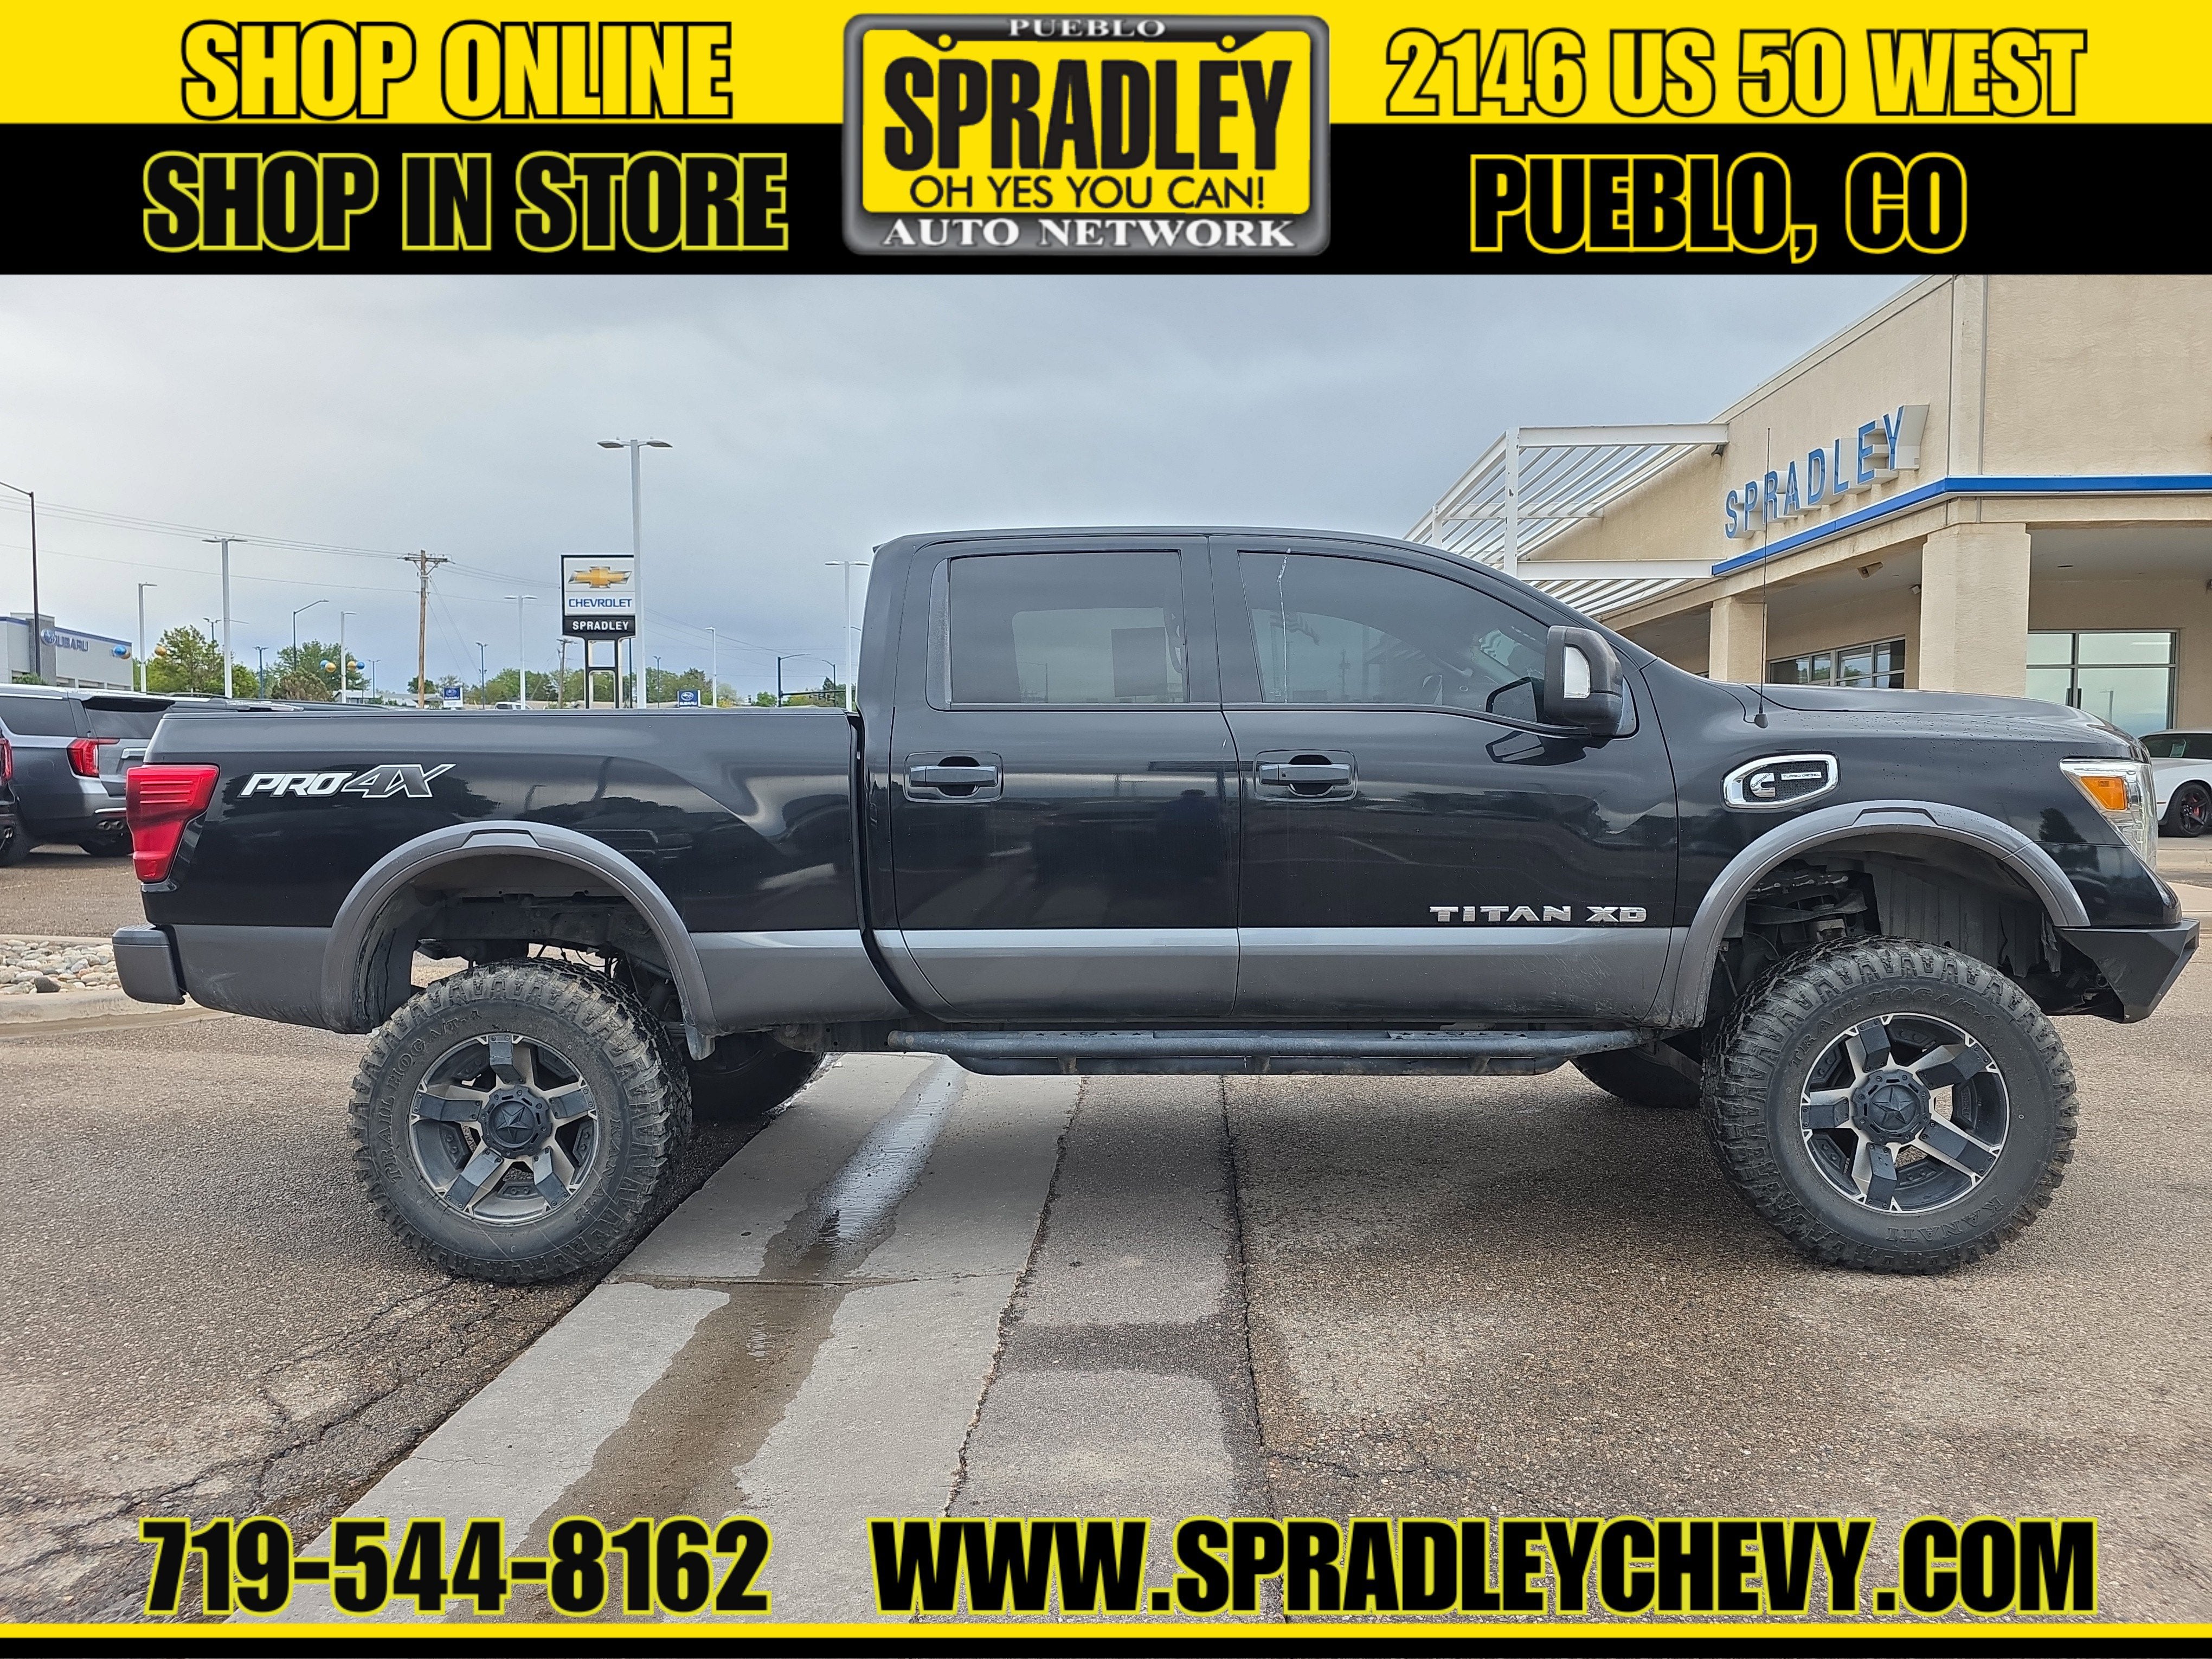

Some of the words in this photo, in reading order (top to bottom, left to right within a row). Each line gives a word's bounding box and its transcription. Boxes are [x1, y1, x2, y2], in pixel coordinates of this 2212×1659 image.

[1725, 405, 1908, 539] SPRADLEY
[569, 599, 632, 607] CHEVROLET
[572, 621, 629, 631] SPRADLEY
[1430, 906, 1571, 922] TITAN
[1585, 906, 1647, 922] XD
[1789, 998, 1861, 1067] TRAIL
[1869, 987, 1932, 1005] HOG
[387, 1038, 426, 1090] HOG
[378, 1096, 404, 1183] TRAIL
[574, 1117, 621, 1225] KANATI
[1886, 1194, 2005, 1243] KANATI
